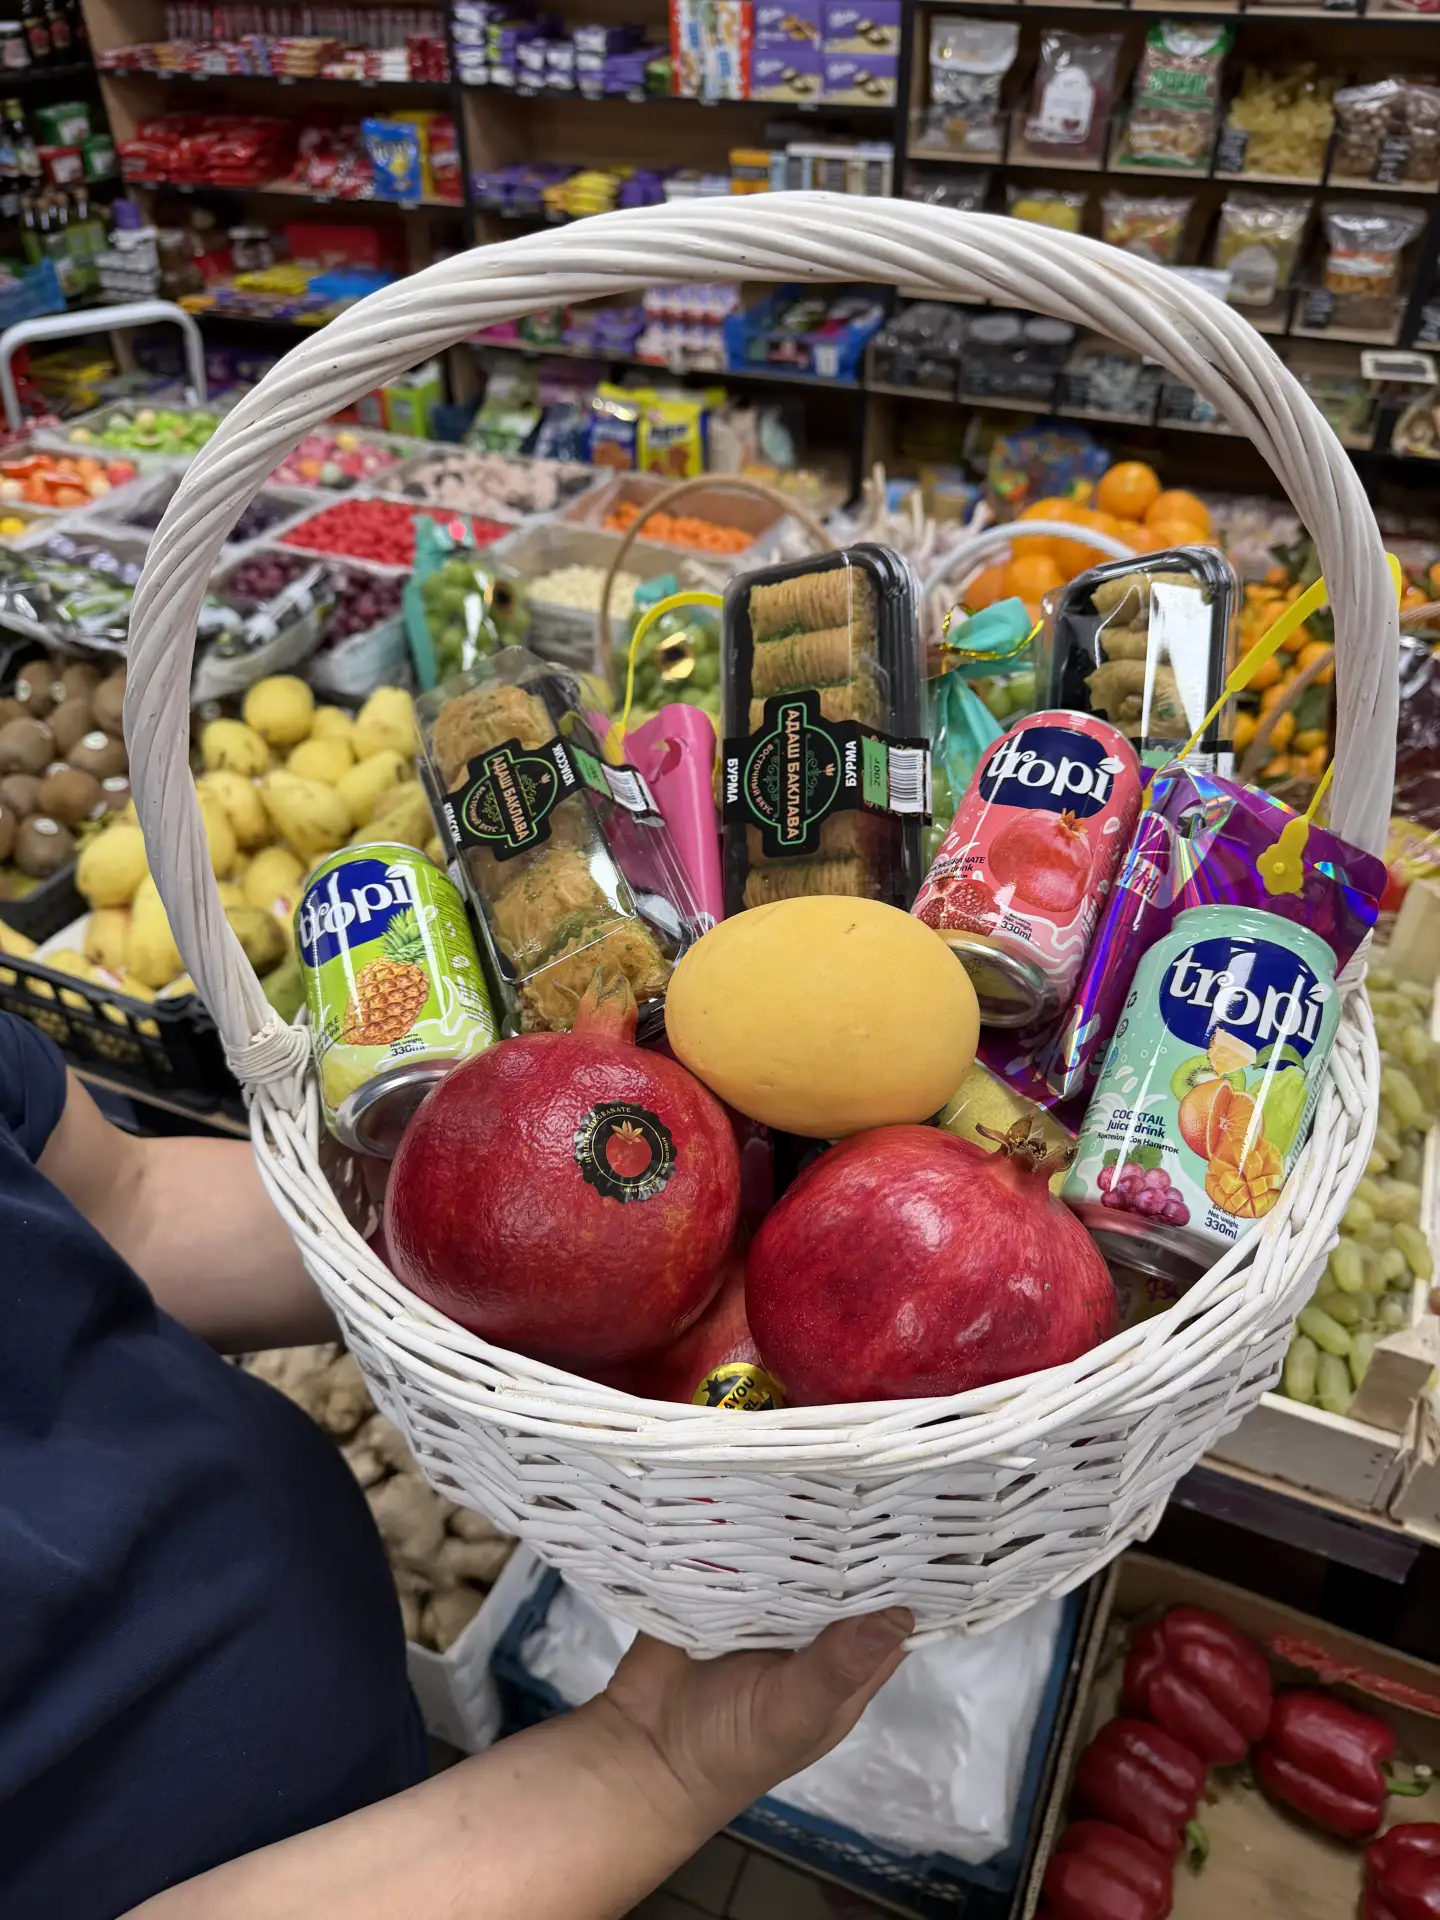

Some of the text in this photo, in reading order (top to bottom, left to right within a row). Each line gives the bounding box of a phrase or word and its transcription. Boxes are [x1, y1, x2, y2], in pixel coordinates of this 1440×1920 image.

[552, 743, 576, 787] КЛАССИК
[751, 743, 774, 816] ВОСТОЧНЫЙ ВКУС
[785, 709, 801, 839] АДАШ БАКЛАВА
[845, 740, 858, 787] БУРМА
[727, 757, 739, 804] БУРМА
[491, 756, 531, 841] АДАШ БАКЛАВА
[1000, 920, 1032, 941] 330ml
[584, 1106, 632, 1138] POMEGRANATE
[1112, 1109, 1166, 1127] COCKTAIL
[1134, 1124, 1166, 1139] drink
[1142, 1138, 1180, 1155] Напиток
[1204, 1216, 1238, 1240] 330ml
[1207, 1209, 1239, 1230] Net weight
